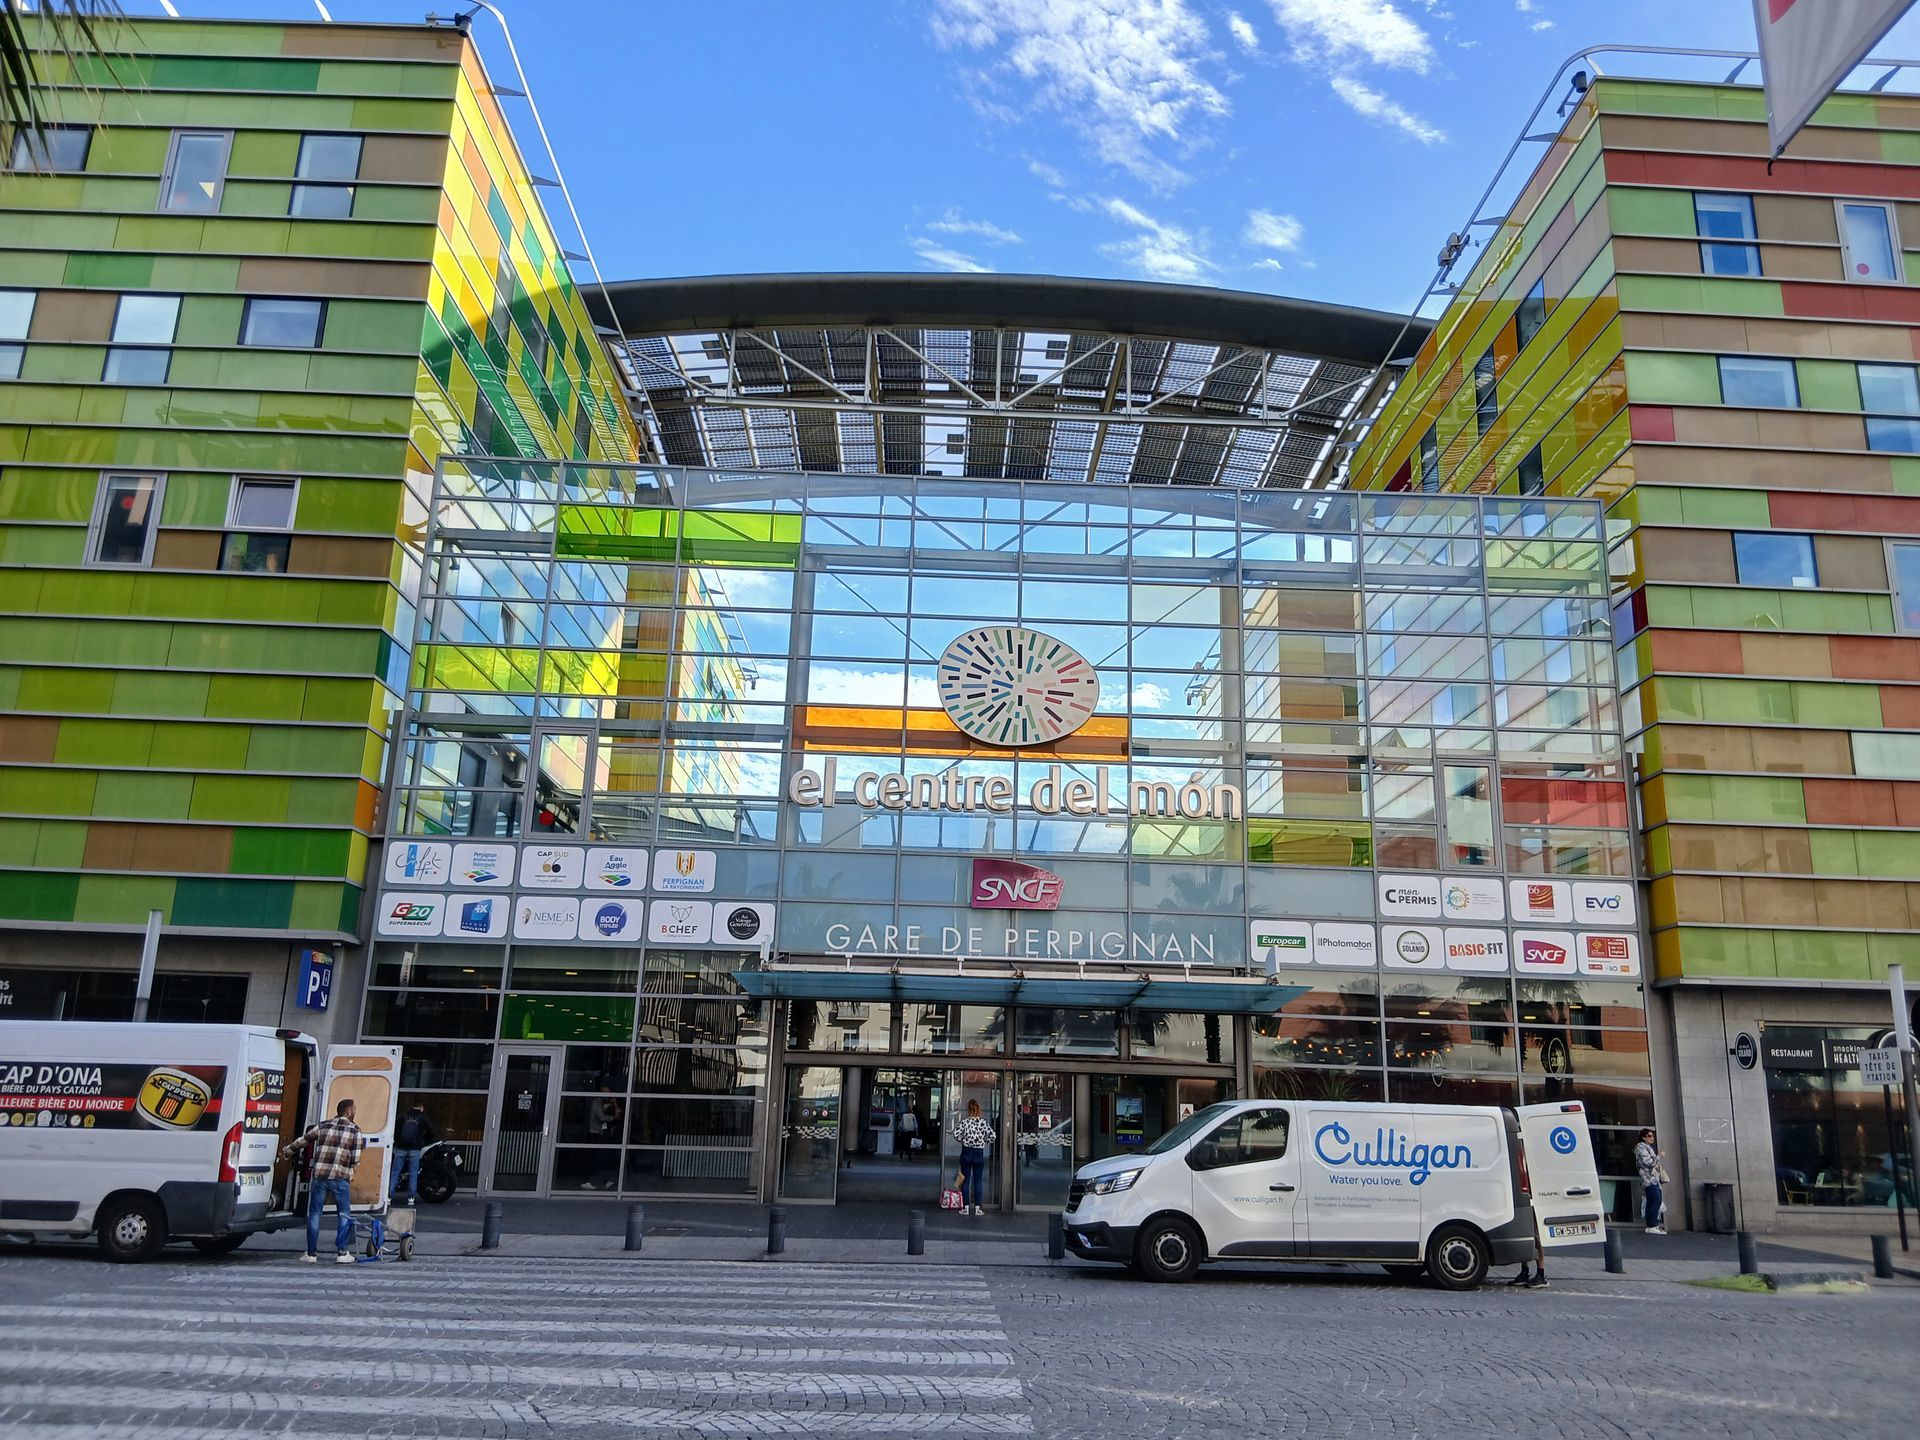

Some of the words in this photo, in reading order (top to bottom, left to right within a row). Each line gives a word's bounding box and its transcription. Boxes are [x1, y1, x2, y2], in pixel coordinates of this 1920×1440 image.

[789, 756, 837, 807] el
[854, 765, 1014, 814] centre
[1030, 765, 1110, 817] del
[1129, 771, 1243, 822] món
[604, 862, 628, 870] Agglo
[662, 877, 705, 886] PERPIGNAN
[975, 876, 1059, 903] SNCF
[1528, 885, 1540, 894] 66
[1385, 888, 1397, 904] C
[1398, 895, 1437, 905] PERMIS
[1585, 897, 1619, 909] EVO
[395, 904, 431, 918] G20
[600, 915, 620, 924] BODY
[661, 925, 698, 934] BCHEF
[825, 923, 921, 952] GARE
[942, 926, 984, 954] DE
[1005, 928, 1215, 961] PERPIGNAN
[1262, 936, 1302, 946] Europcar
[1322, 938, 1372, 948] Photomaton
[1449, 942, 1504, 957] BASIC-FIT
[1525, 949, 1564, 961] SNCF
[307, 970, 321, 1005] P
[1770, 1048, 1814, 1058] RESTAURANT
[1869, 1052, 1889, 1060] TAXIS
[1865, 1062, 1881, 1071] TÊTE
[1886, 1062, 1896, 1070] DE
[37, 1066, 103, 1086] D'ONA
[1, 1083, 25, 1094] BIÈRE
[26, 1085, 40, 1094] DU
[40, 1085, 62, 1095] PAYS
[63, 1087, 102, 1095] CATALAN
[0, 1097, 37, 1108] LLEURE
[38, 1097, 67, 1109] BIÈRE
[68, 1099, 83, 1109] DU
[85, 1100, 125, 1110] MONDE
[1315, 1121, 1472, 1186] Culligan
[1329, 1175, 1360, 1186] Water
[1360, 1178, 1379, 1188] you
[1381, 1176, 1403, 1187] love.
[1233, 1196, 1285, 1205] www.culligan.fr
